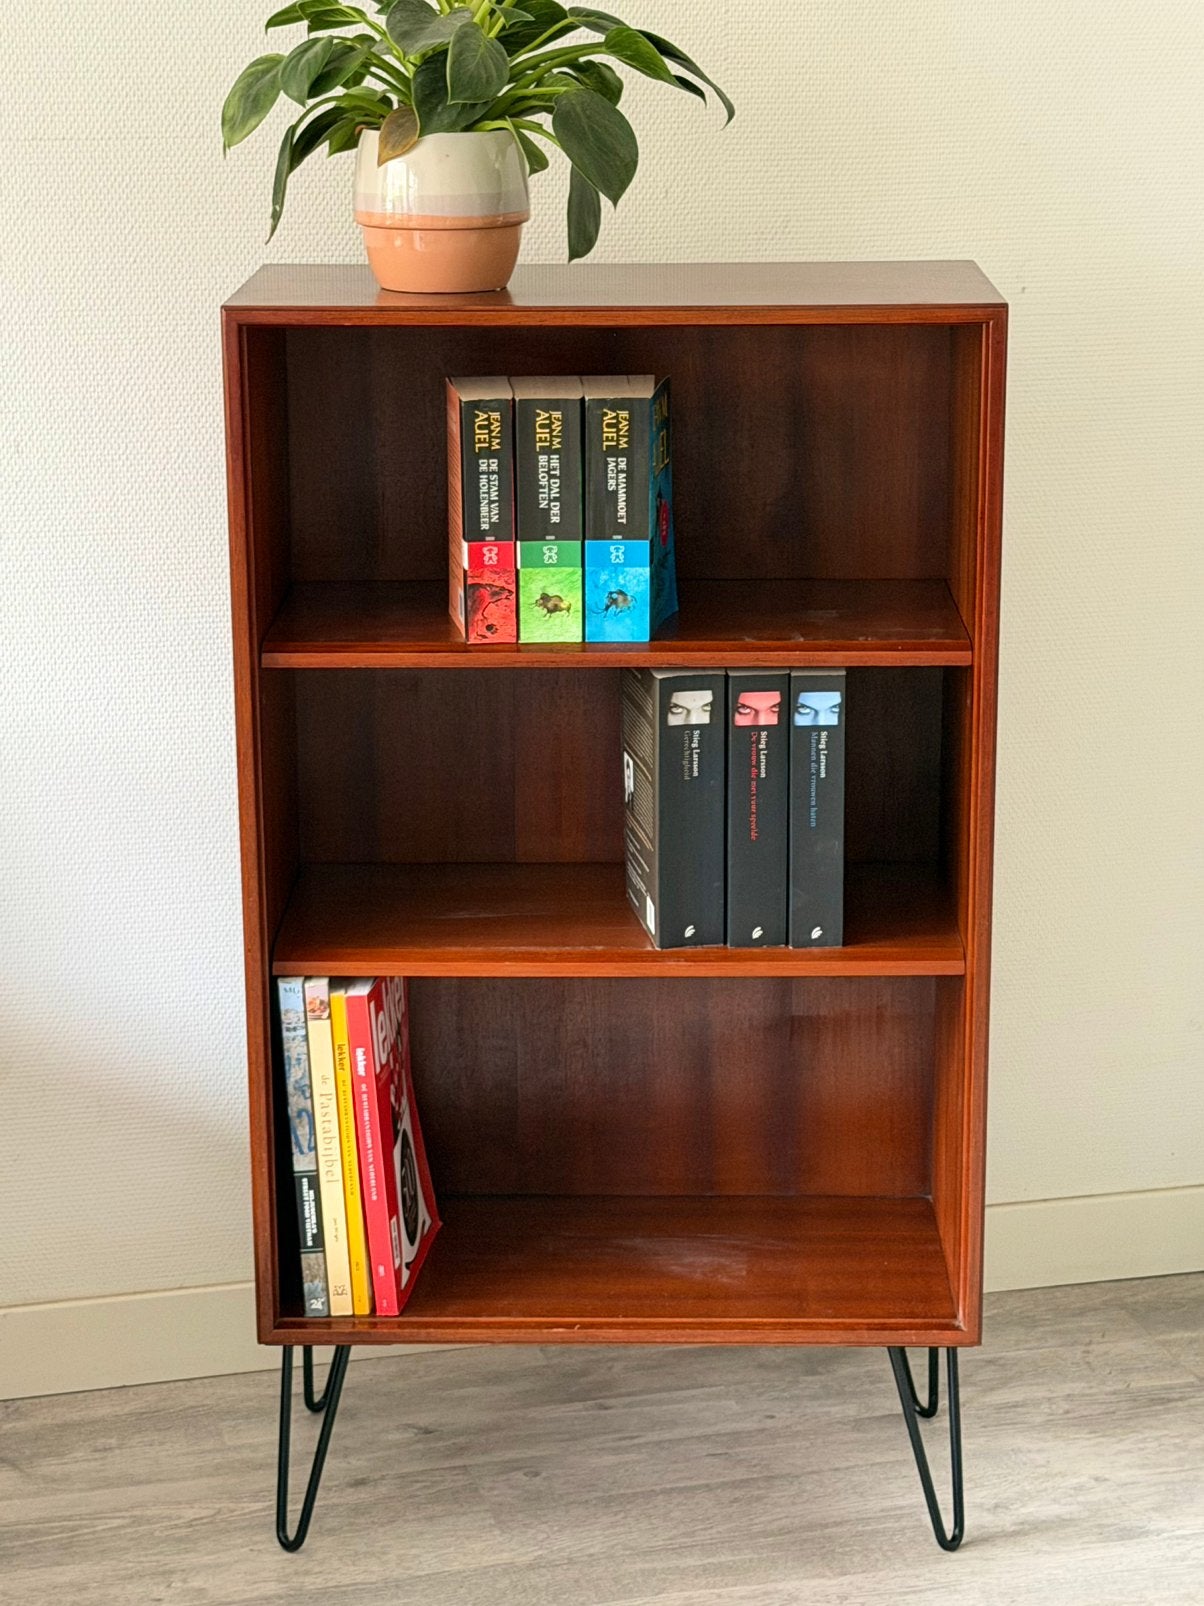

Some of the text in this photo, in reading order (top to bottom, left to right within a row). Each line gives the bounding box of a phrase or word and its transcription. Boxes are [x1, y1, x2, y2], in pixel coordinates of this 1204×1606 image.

[475, 411, 488, 452] AUEL
[489, 412, 501, 449] JEAN M
[536, 410, 549, 451] AUEL
[550, 411, 562, 448] JEAN M
[603, 409, 616, 451] AUEL
[618, 411, 629, 448] JEAN M
[489, 459, 498, 522] DE STAM VAN
[539, 455, 548, 508] BELOFTEN
[549, 455, 560, 523] HET DAL DER
[607, 457, 616, 491] JAGERS
[618, 457, 626, 524] DE MAMMOET
[479, 459, 489, 530] DE HOLENBEER
[692, 730, 700, 748] Stieg
[751, 732, 757, 741] De
[759, 731, 767, 749] Stieg
[819, 731, 828, 749] Stieg
[749, 814, 758, 840] speelde
[337, 1044, 347, 1071] lekker
[355, 1047, 366, 1076] lekker
[319, 1075, 339, 1184] de Pastabijbel
